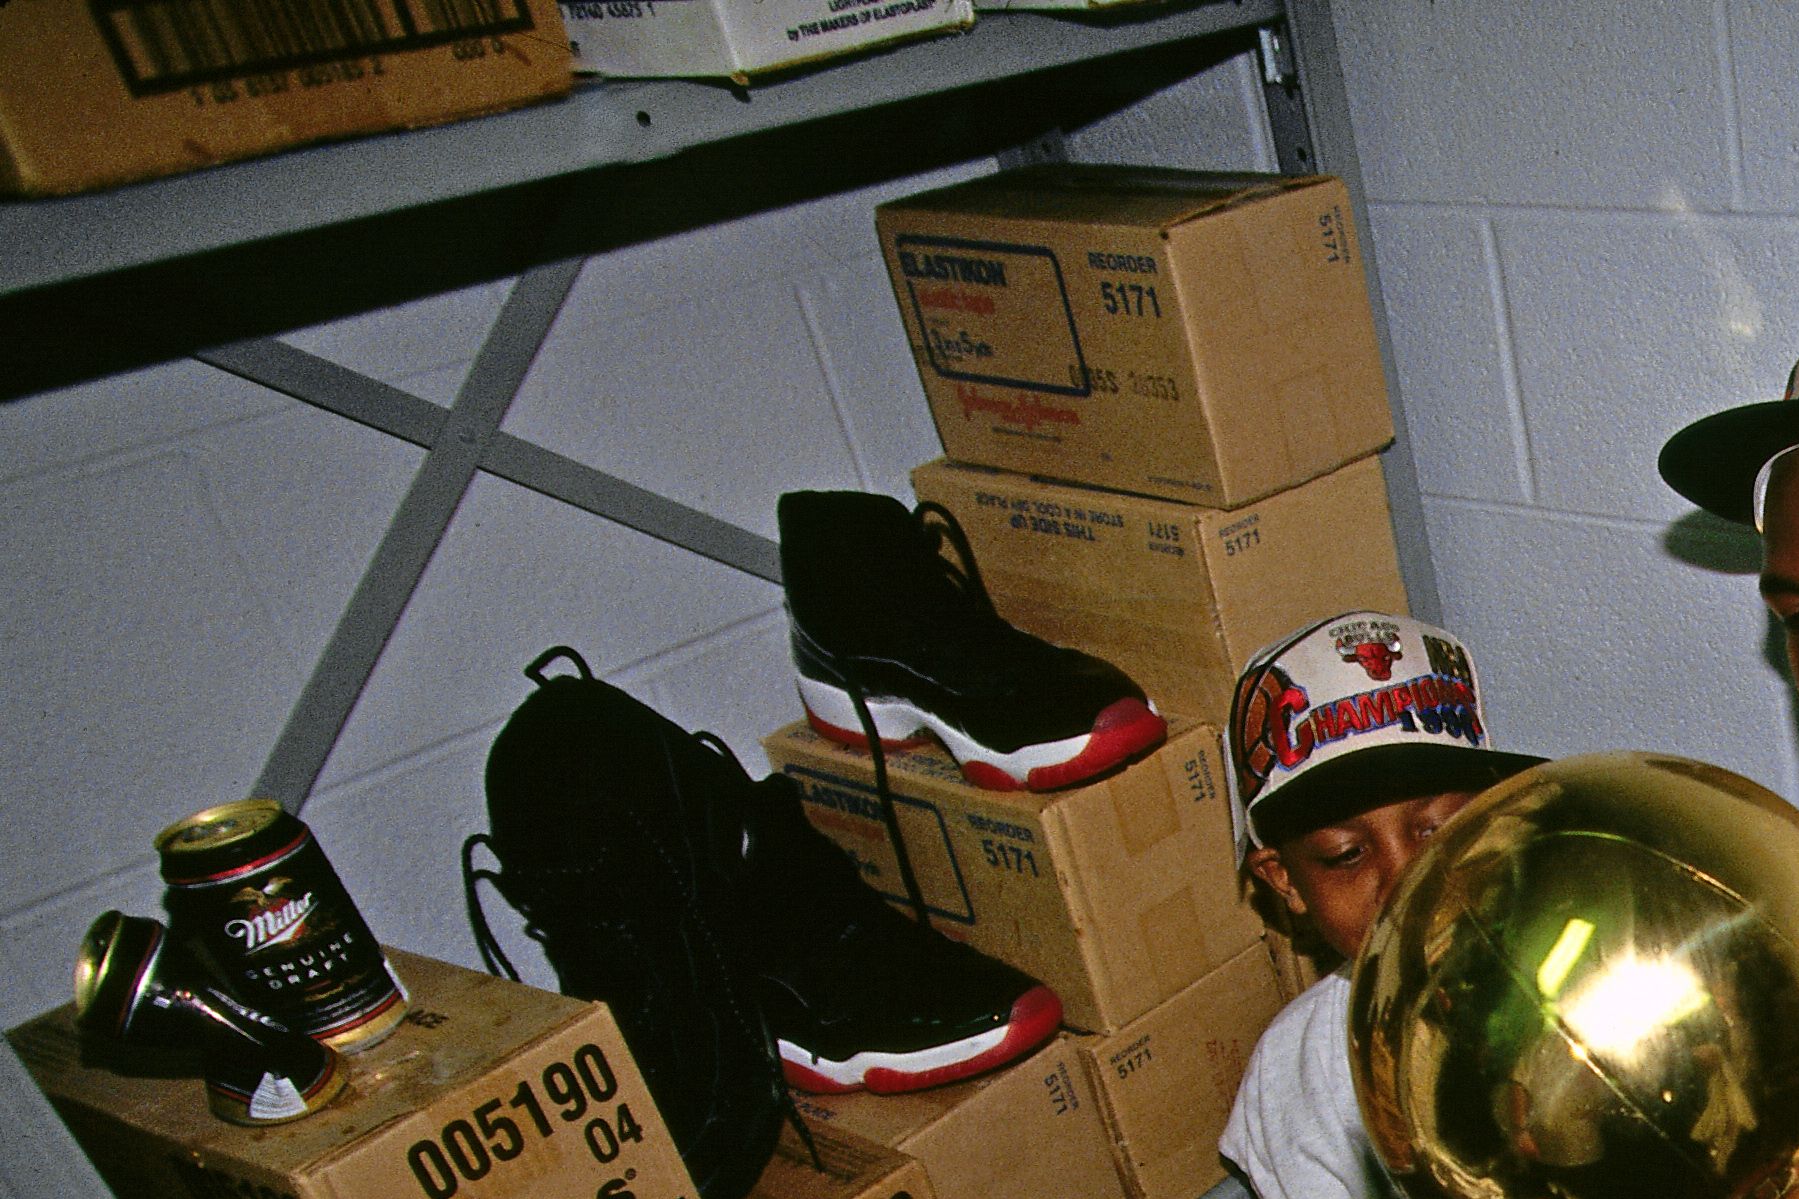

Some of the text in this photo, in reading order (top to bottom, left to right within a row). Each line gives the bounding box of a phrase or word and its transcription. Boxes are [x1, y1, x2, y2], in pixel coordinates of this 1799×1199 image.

[1319, 211, 1340, 263] 5171
[1088, 251, 1158, 273] REORDER
[1101, 281, 1161, 318] 5171
[1224, 527, 1262, 557] 5171
[1184, 759, 1206, 802] 5171
[982, 839, 1039, 878] 5171
[224, 890, 313, 950] Miller
[246, 931, 353, 980] GENUINE
[267, 952, 351, 990] DRAFT
[1116, 1048, 1153, 1080] 5171
[1044, 1073, 1068, 1116] 5171
[583, 1103, 644, 1166] 04
